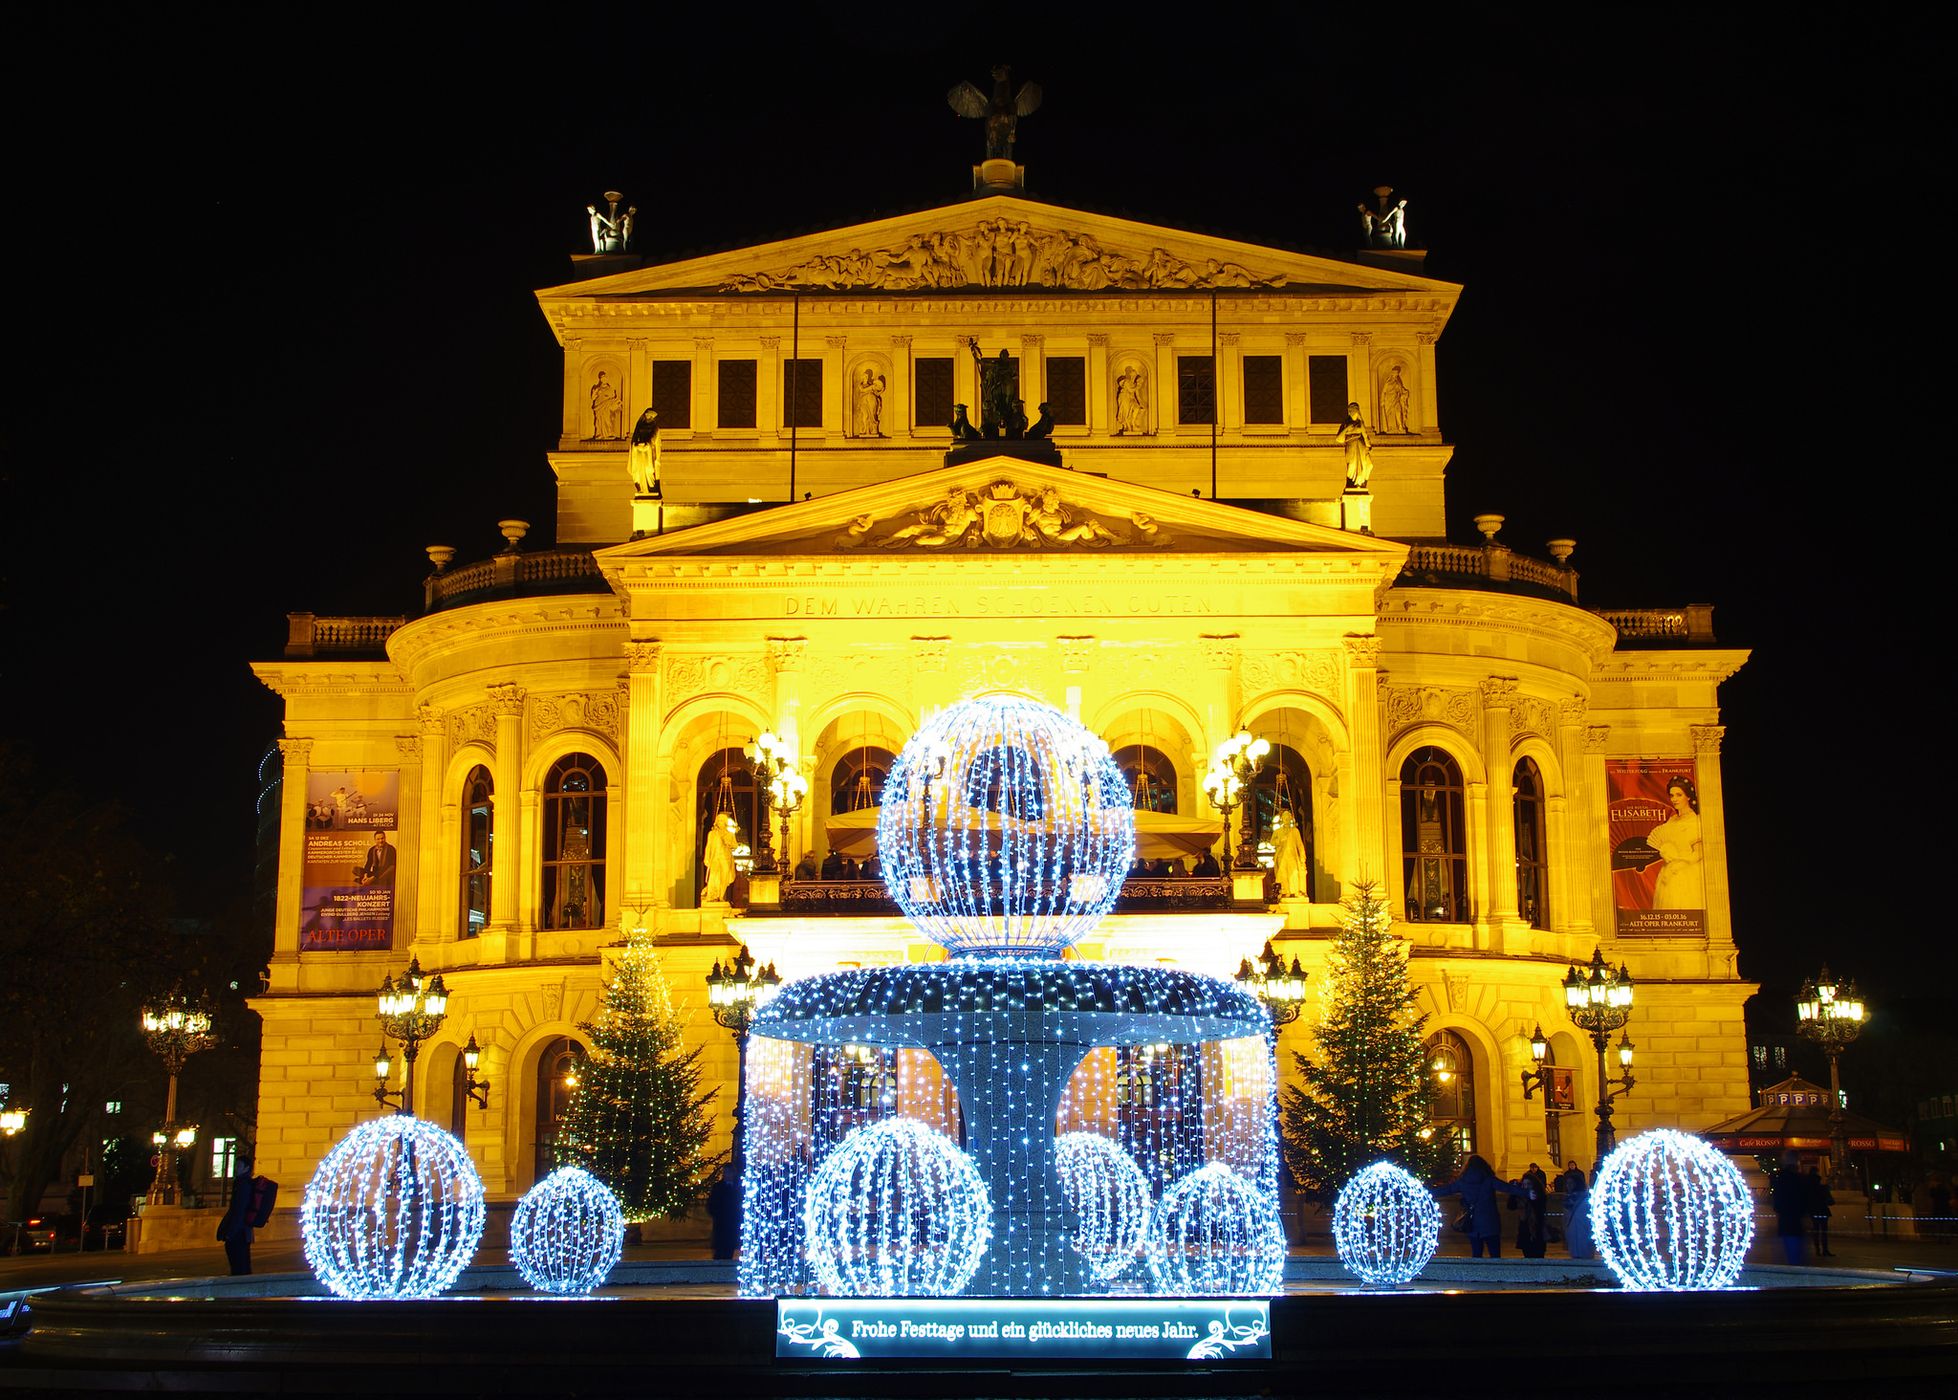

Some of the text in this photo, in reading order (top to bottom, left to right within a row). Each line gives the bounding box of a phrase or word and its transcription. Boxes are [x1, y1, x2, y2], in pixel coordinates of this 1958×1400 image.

[785, 596, 838, 615] DEM
[852, 596, 960, 615] WAHREN
[976, 596, 1111, 614] SCHOENEN
[1611, 809, 1666, 821] ELISABETH
[306, 928, 386, 943] ALTE OPER
[851, 1320, 1199, 1342] Frohe Festtage und ein glückliches neues Jahr.
